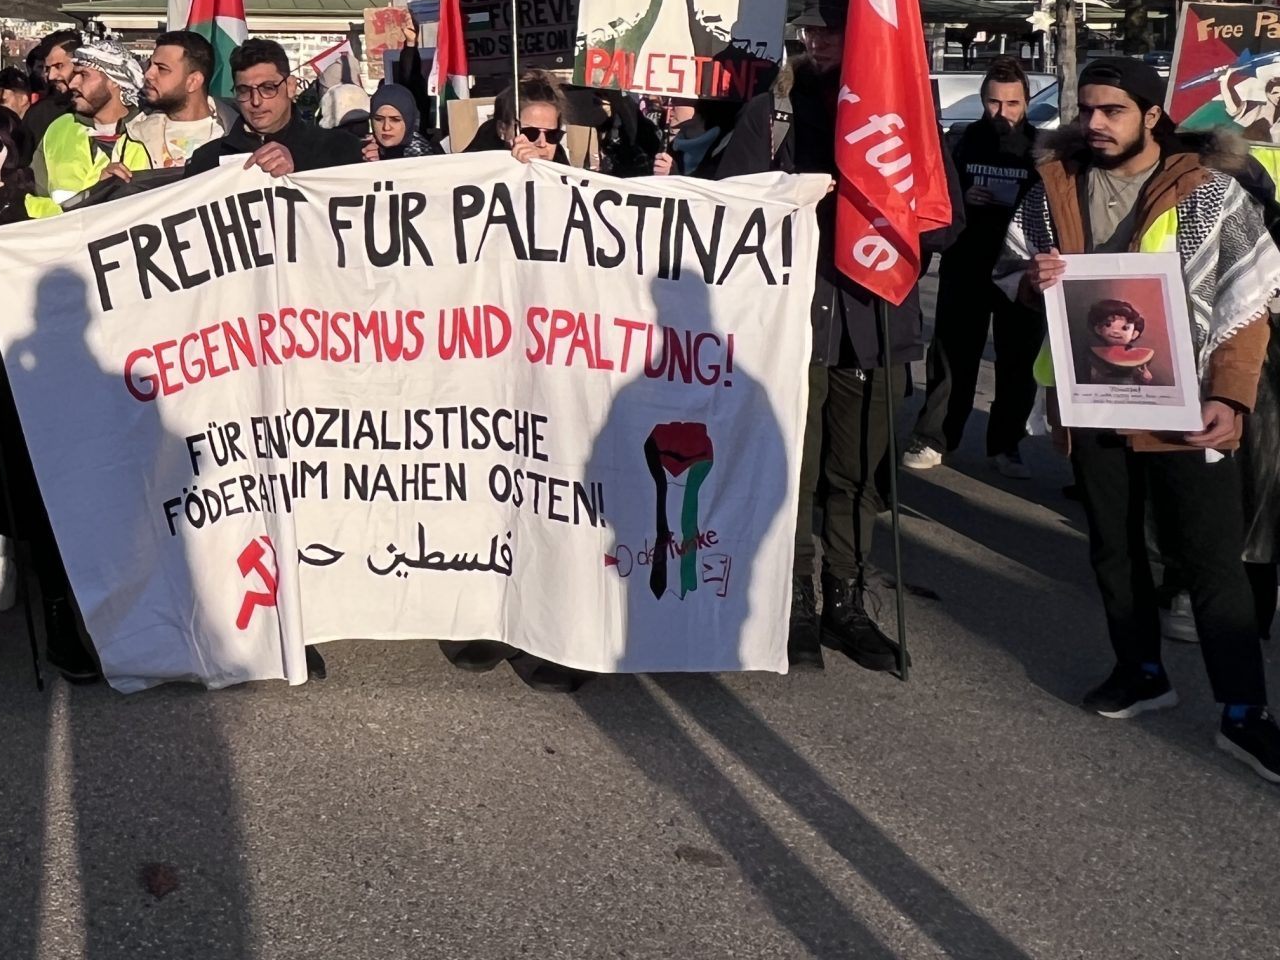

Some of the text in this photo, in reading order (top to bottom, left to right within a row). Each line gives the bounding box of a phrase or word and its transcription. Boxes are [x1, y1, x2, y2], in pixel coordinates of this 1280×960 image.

[1197, 18, 1243, 41] Free
[88, 175, 799, 311] FREIHEIT FÜR PALÄSTINA!
[124, 317, 257, 402] GEGEN
[438, 304, 512, 361] UND
[526, 307, 734, 387] SPALTUNG!
[185, 421, 247, 476] FÜR
[292, 461, 327, 500] IM
[344, 462, 467, 501] NAHEN
[489, 464, 606, 528] OSTEN!
[367, 522, 513, 578] فلسطين
